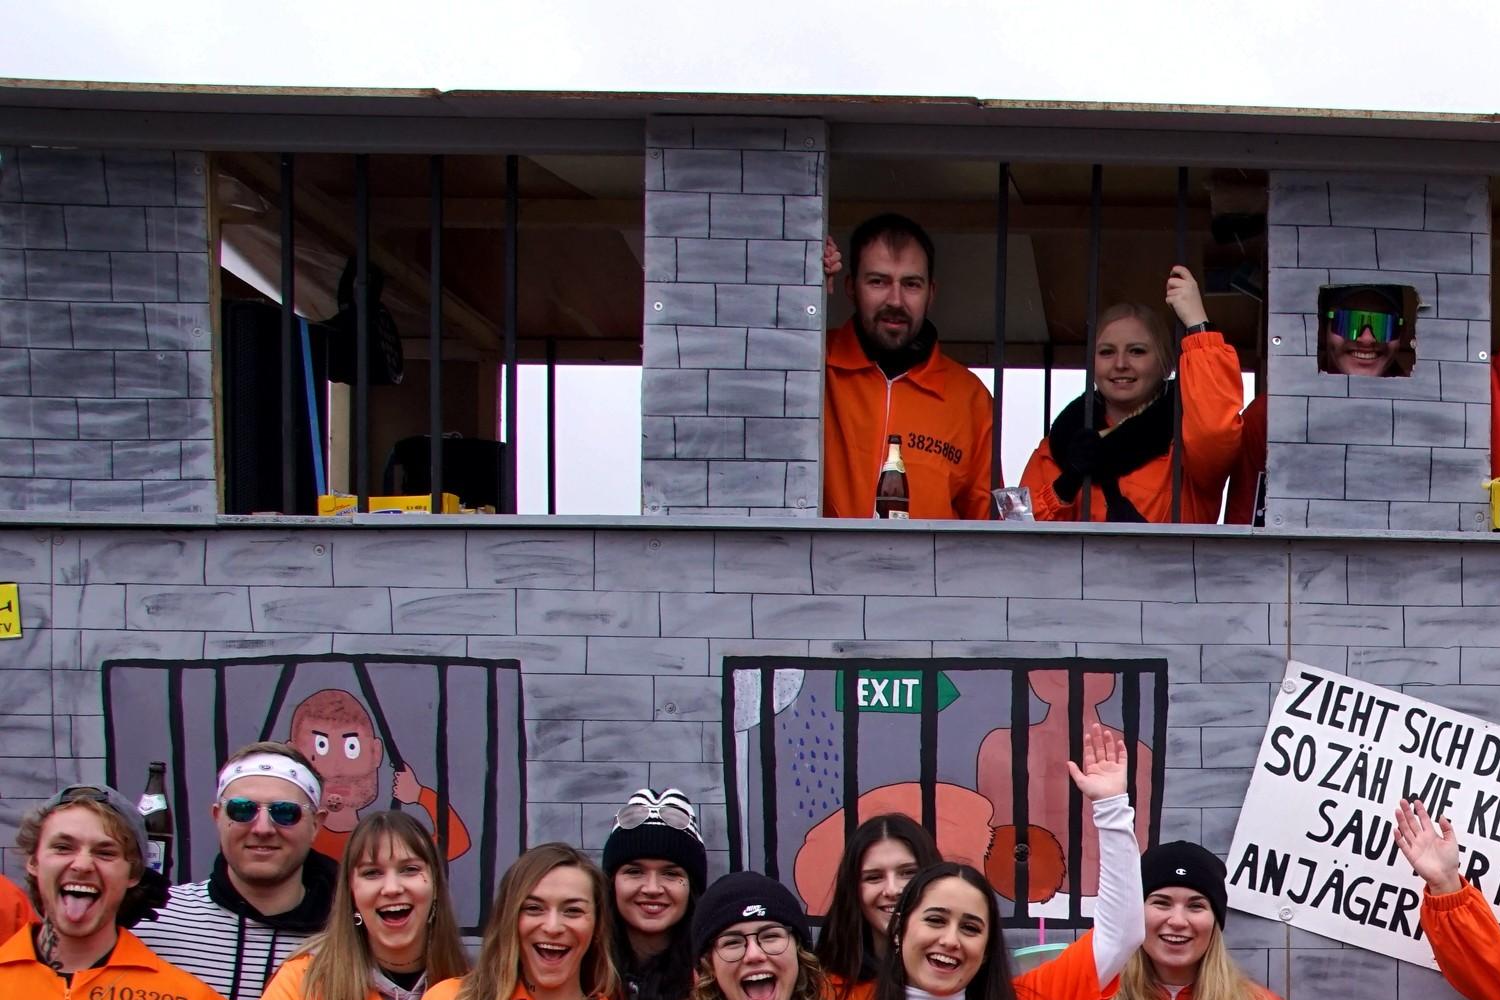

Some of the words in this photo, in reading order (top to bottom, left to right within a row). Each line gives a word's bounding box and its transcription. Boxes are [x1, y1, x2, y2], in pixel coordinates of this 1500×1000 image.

[907, 432, 963, 464] 3825869
[857, 678, 920, 708] EXIT
[1286, 671, 1400, 743] ZIEHT
[1399, 707, 1479, 770] SICH
[1264, 725, 1317, 783] SO
[1318, 742, 1393, 804] ZÄH
[1402, 765, 1461, 823] WIE
